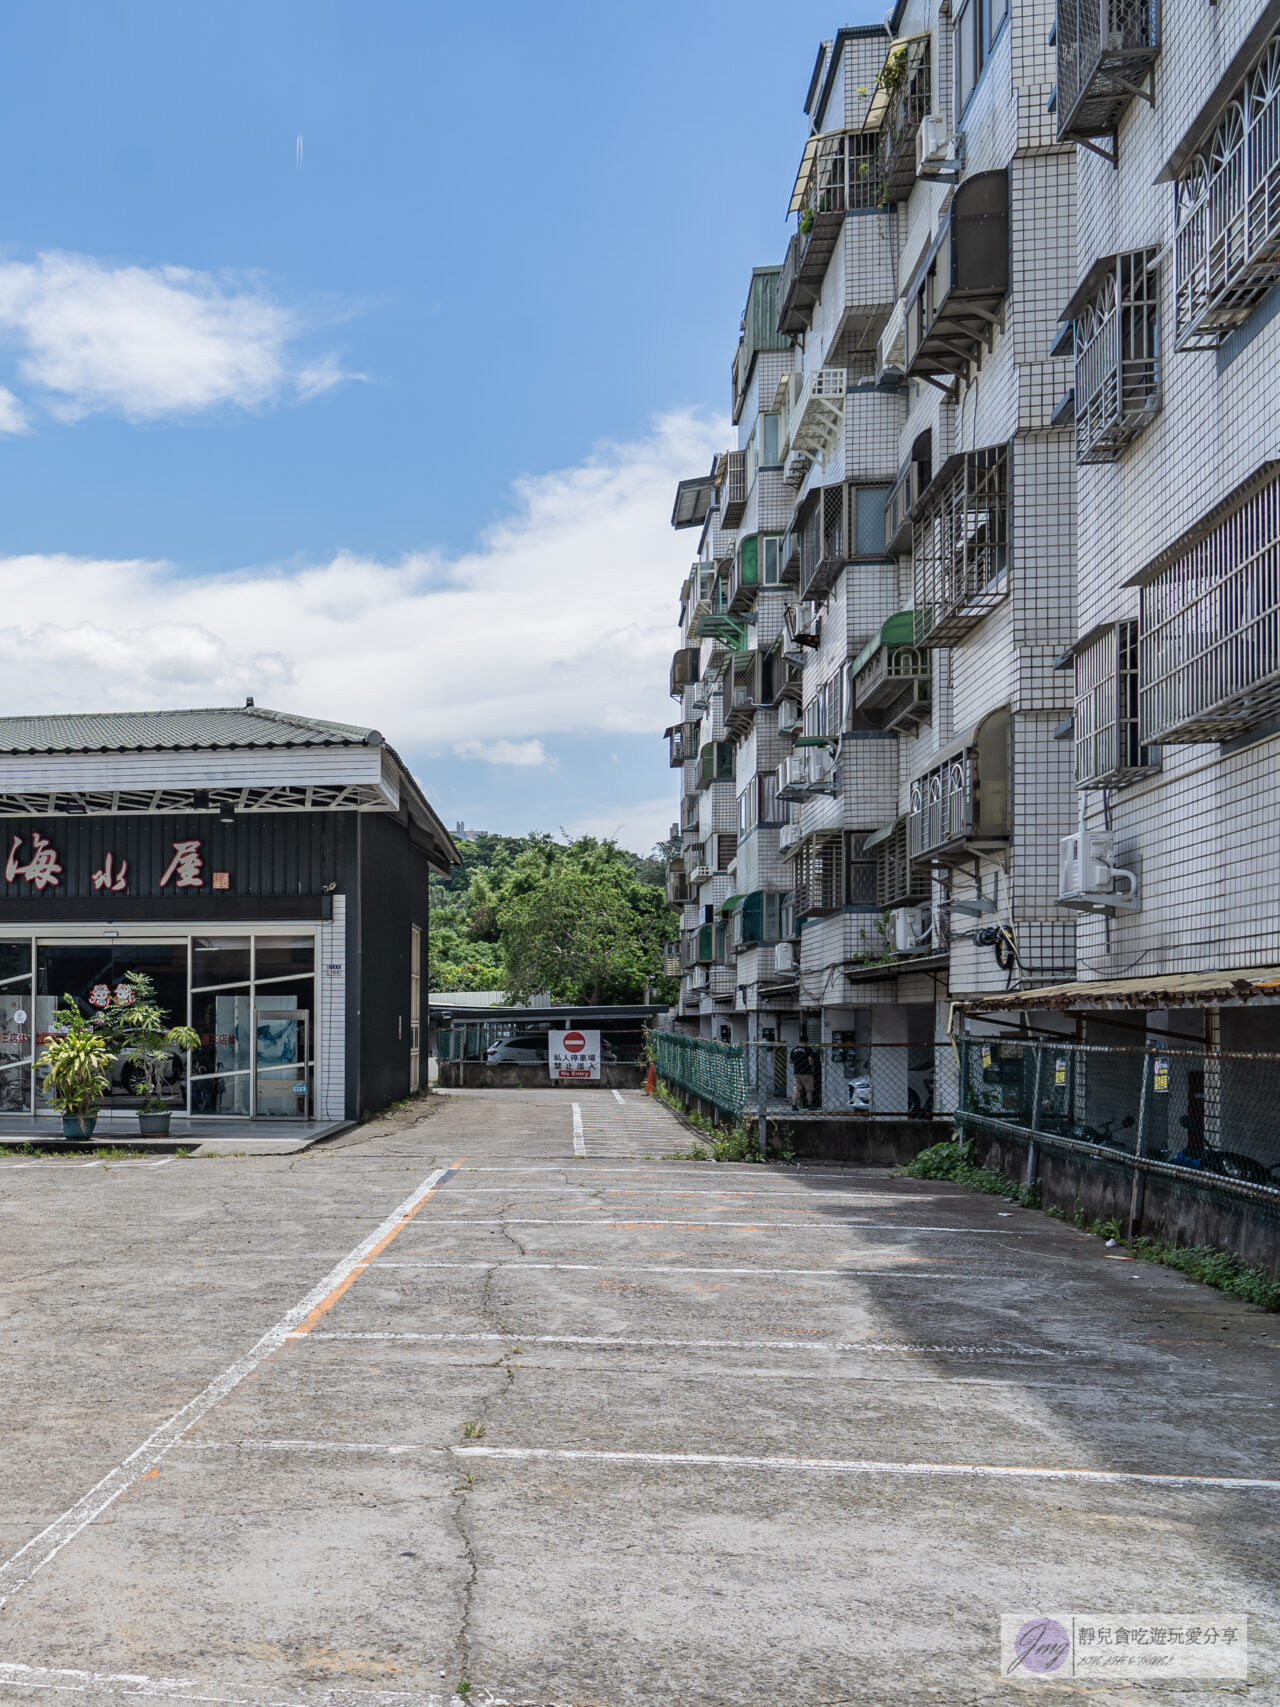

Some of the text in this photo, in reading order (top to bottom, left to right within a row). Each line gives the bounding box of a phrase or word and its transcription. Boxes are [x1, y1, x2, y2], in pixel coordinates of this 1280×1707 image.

[5, 832, 204, 890] 海水屋
[554, 1054, 596, 1062] 私人停車場
[554, 1062, 596, 1070] 禁止進入
